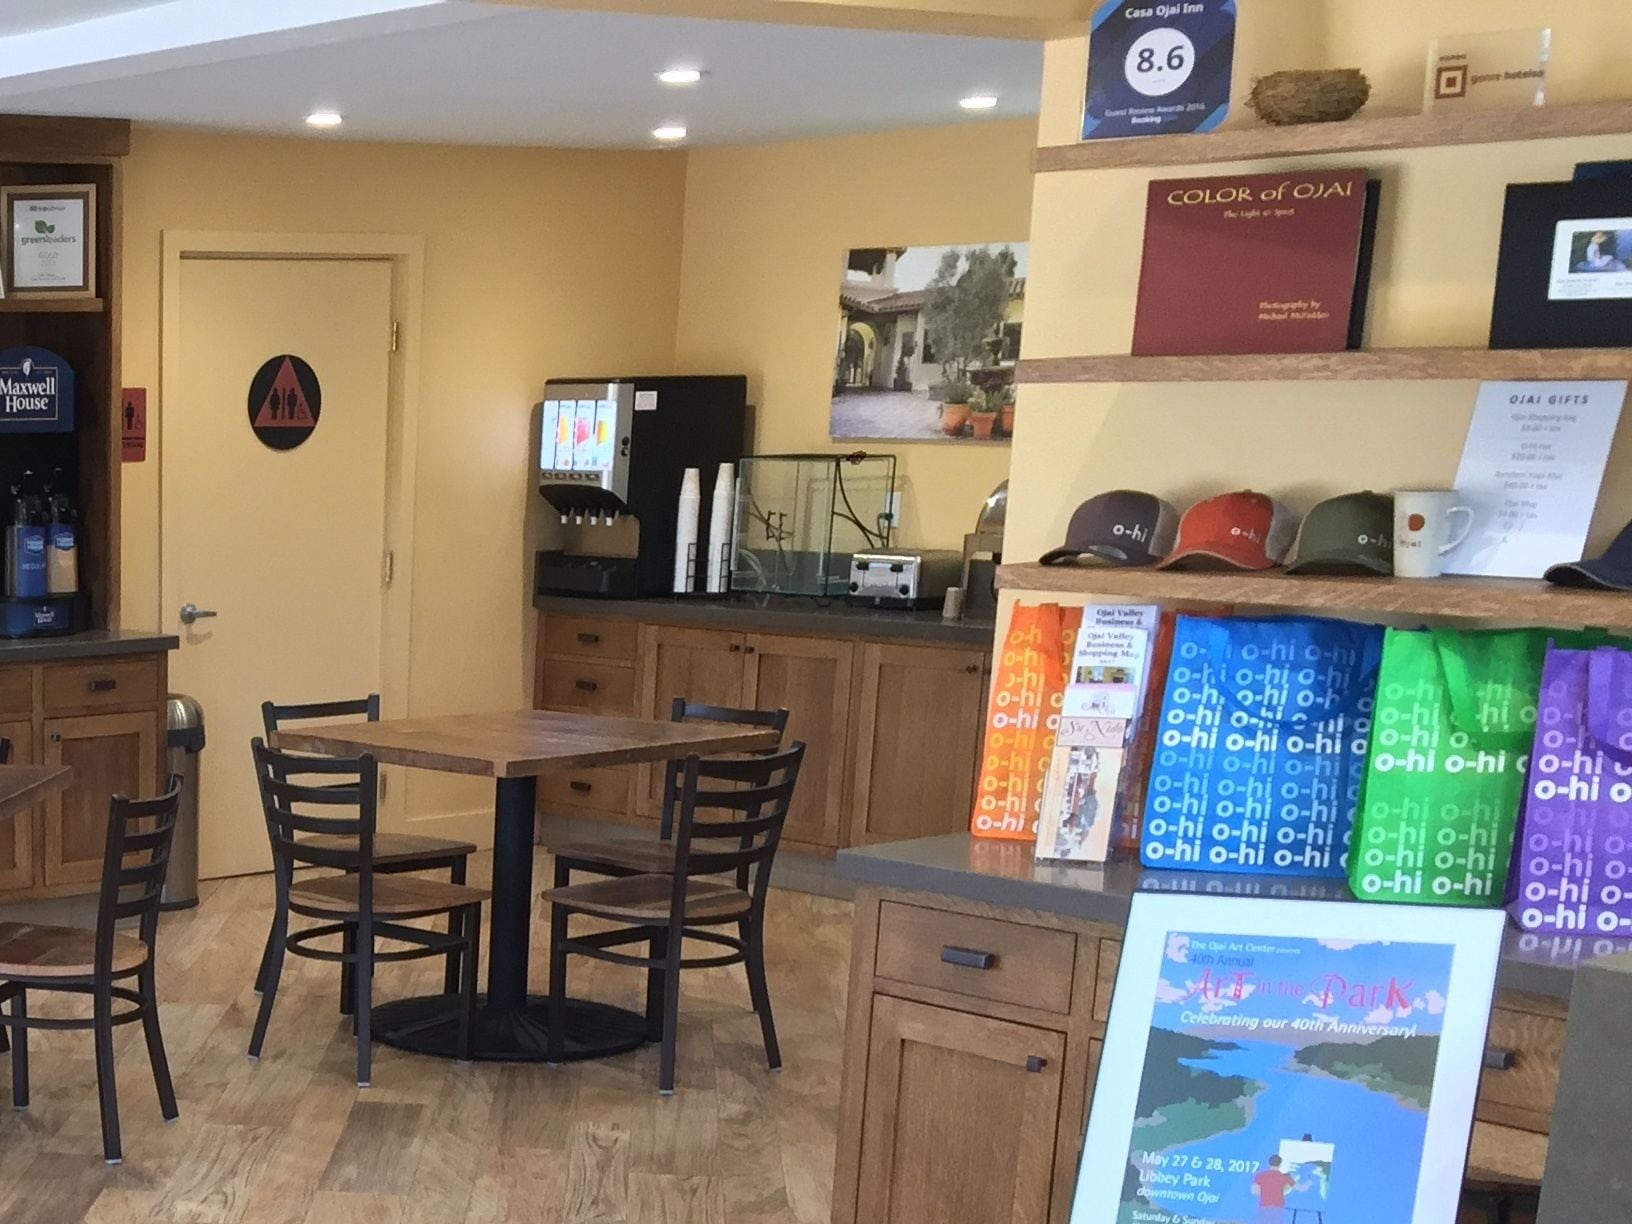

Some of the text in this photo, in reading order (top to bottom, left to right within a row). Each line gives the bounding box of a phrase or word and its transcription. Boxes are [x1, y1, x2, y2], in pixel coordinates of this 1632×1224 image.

[1125, 3, 1204, 19] Casa Ojai Inn
[1136, 45, 1185, 73] 8.6
[1168, 181, 1353, 205] COLOR of OJAI
[1310, 300, 1320, 310] by
[0, 377, 55, 413] Maxwell House
[1509, 394, 1590, 404] OJAI GIFTS
[1113, 524, 1148, 543] o-hi
[1230, 526, 1262, 545] o-hi
[1097, 609, 1144, 617] Ojai Valley
[1087, 641, 1124, 649] Business
[1088, 632, 1134, 641] Ojai Valley
[1079, 650, 1118, 658] Shopping
[996, 688, 1042, 707] o-hi
[992, 711, 1039, 729] o-hi
[1168, 705, 1222, 726] o-hi
[1163, 727, 1341, 754] o-hi o-hi o-hi
[1375, 749, 1506, 773] o-hi o-hi
[1539, 750, 1603, 775] o-hi
[1534, 776, 1600, 801] o-hi
[981, 793, 1027, 812] o-hi
[976, 814, 1025, 832] o-hi
[1149, 816, 1332, 845] o-hi o-hi o-hi
[1146, 839, 1329, 868] o-hi o-hi o-hi
[1362, 870, 1493, 895] o-hi o-hi
[1525, 877, 1590, 903] o-hi
[1522, 903, 1587, 929] o-hi
[1191, 940, 1206, 950] The
[1208, 941, 1227, 952] Ojai
[1229, 941, 1243, 951] Art
[1245, 942, 1276, 953] Center
[1190, 953, 1255, 968] 40th Annual
[1257, 980, 1272, 993] in
[1277, 978, 1304, 996] the
[1180, 1010, 1418, 1040] Celebrating our 40th Anniversary!
[1142, 1151, 1260, 1173] May 27 & 28, 2017
[1139, 1169, 1211, 1188] Libbey Park
[1137, 1186, 1221, 1205] downtown Ojai
[1132, 1210, 1170, 1224] Saturday
[1172, 1215, 1180, 1224] &
